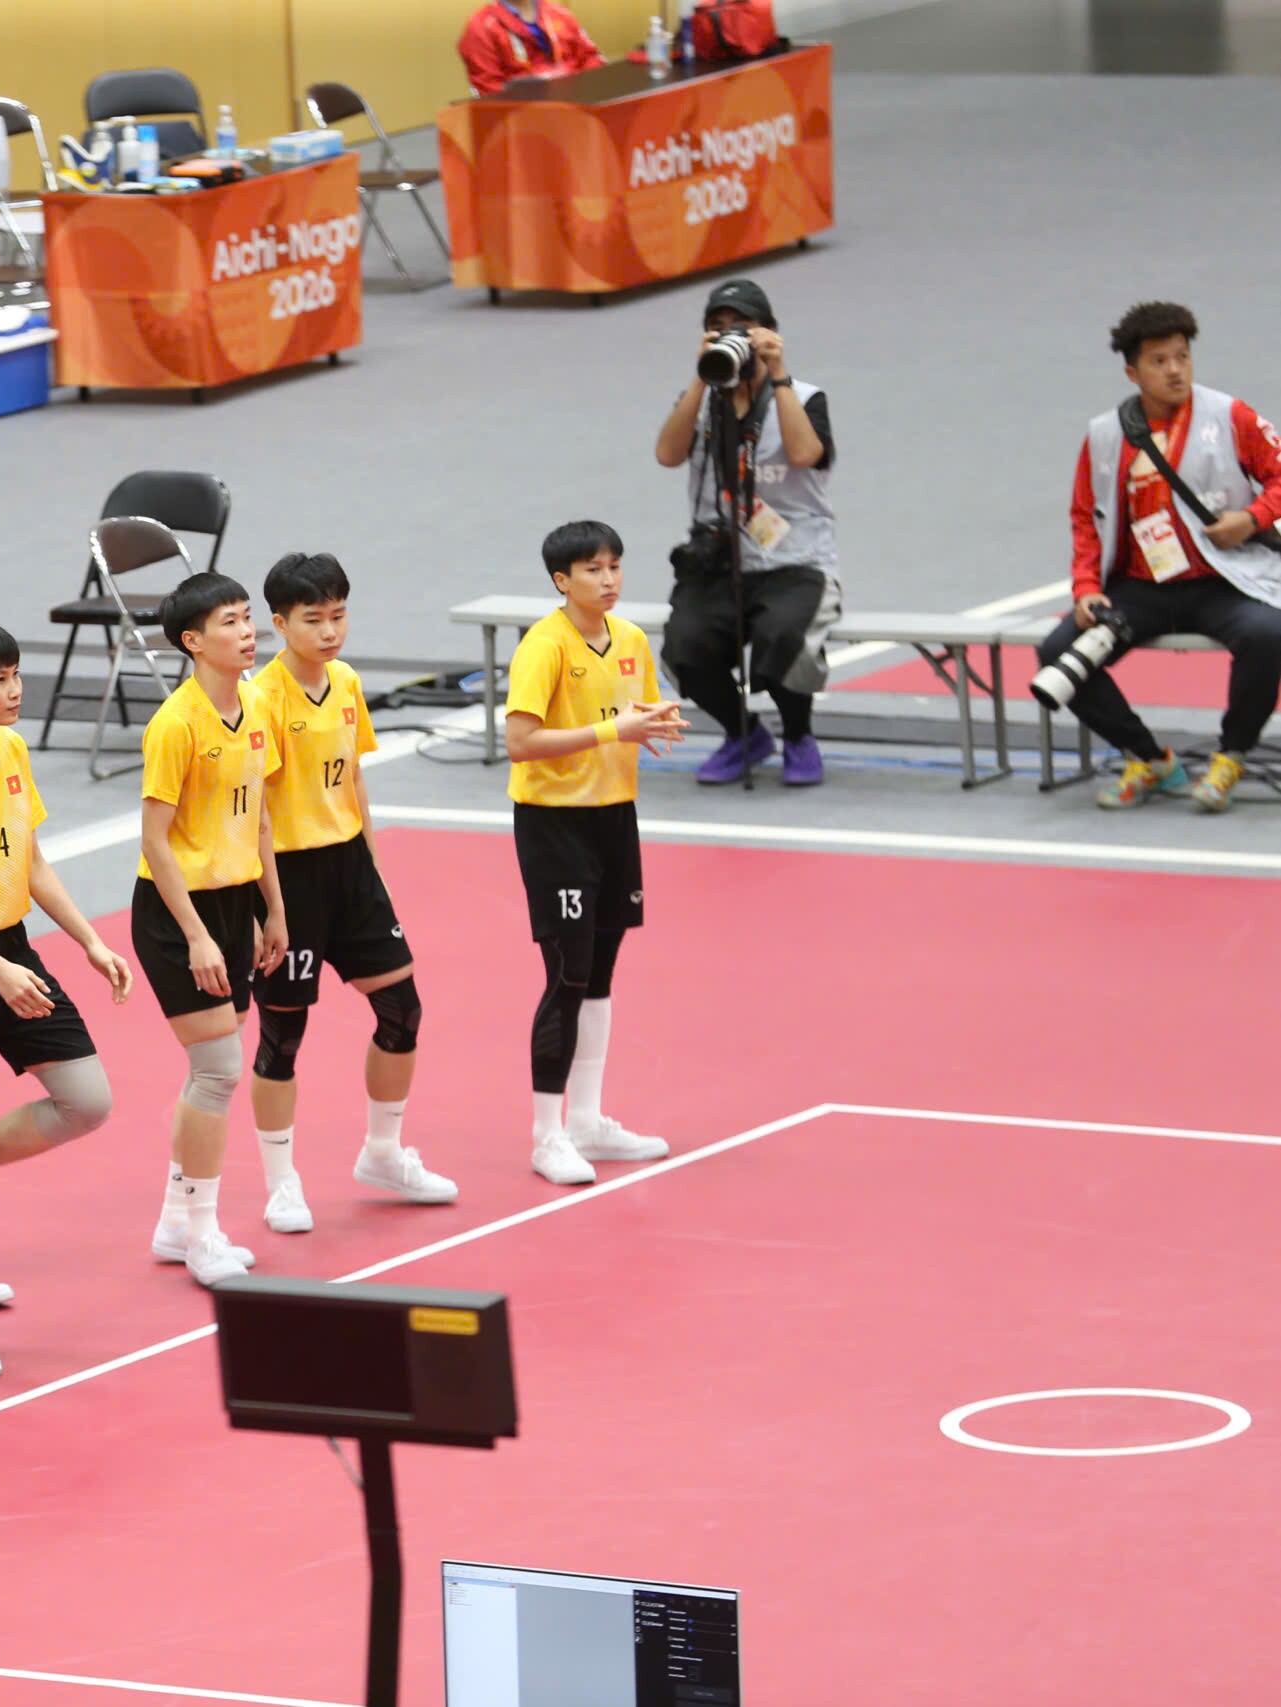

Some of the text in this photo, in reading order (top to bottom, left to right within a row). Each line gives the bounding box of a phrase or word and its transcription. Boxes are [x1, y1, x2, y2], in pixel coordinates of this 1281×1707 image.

[630, 113, 797, 188] Aichi-Nagoya
[684, 170, 749, 225] 2026
[268, 266, 337, 320] 2026
[322, 759, 344, 789] 12
[232, 786, 248, 816] 11
[0, 827, 10, 857] 4
[557, 888, 583, 920] 13
[286, 948, 314, 982] 12
